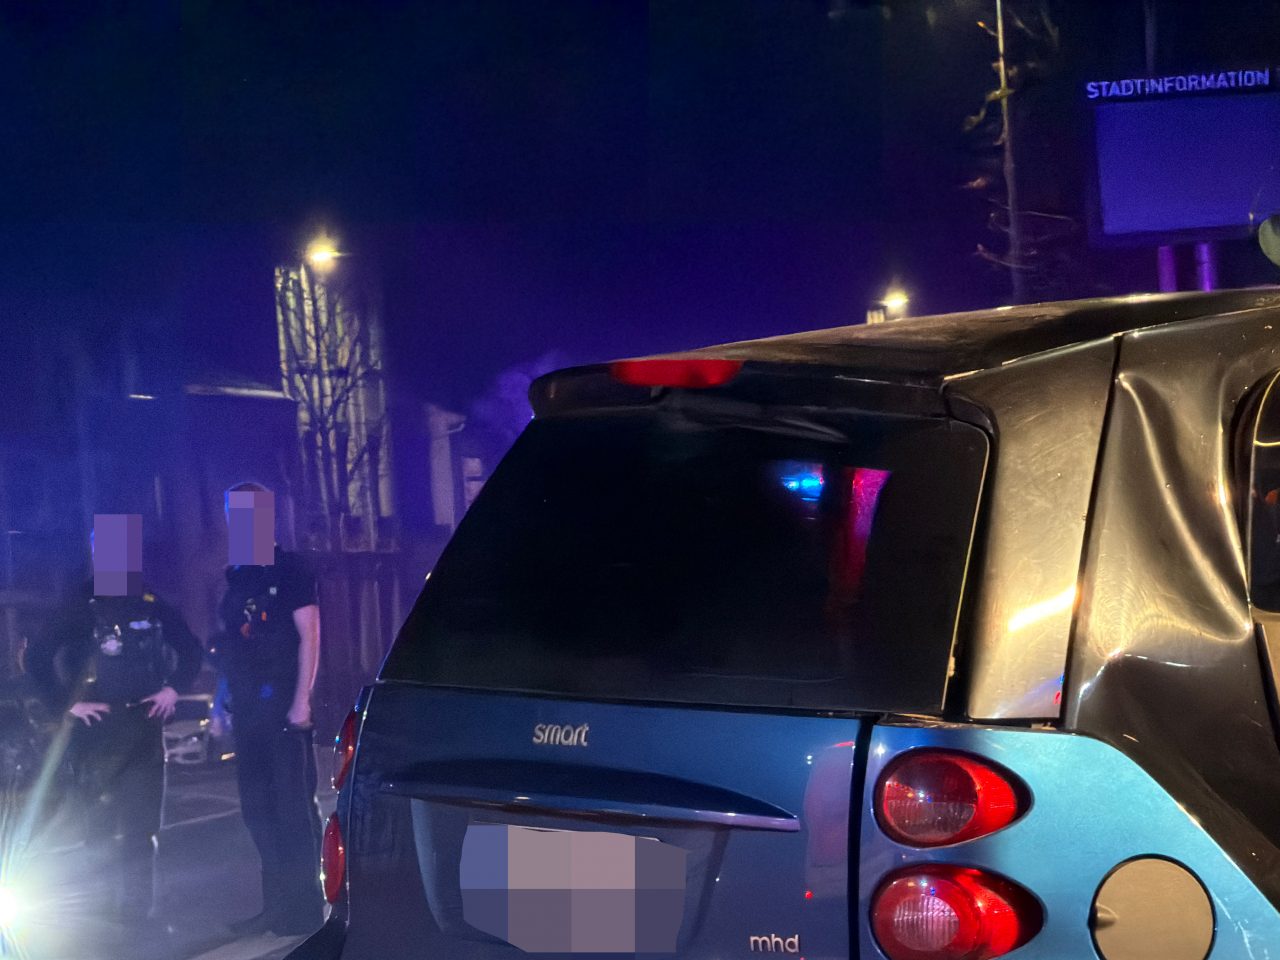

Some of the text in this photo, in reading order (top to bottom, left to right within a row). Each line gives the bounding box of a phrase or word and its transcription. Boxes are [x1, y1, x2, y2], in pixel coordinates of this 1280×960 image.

[1086, 69, 1269, 98] STADTINFORMATION
[533, 723, 589, 746] smart
[750, 934, 799, 953] mhd
